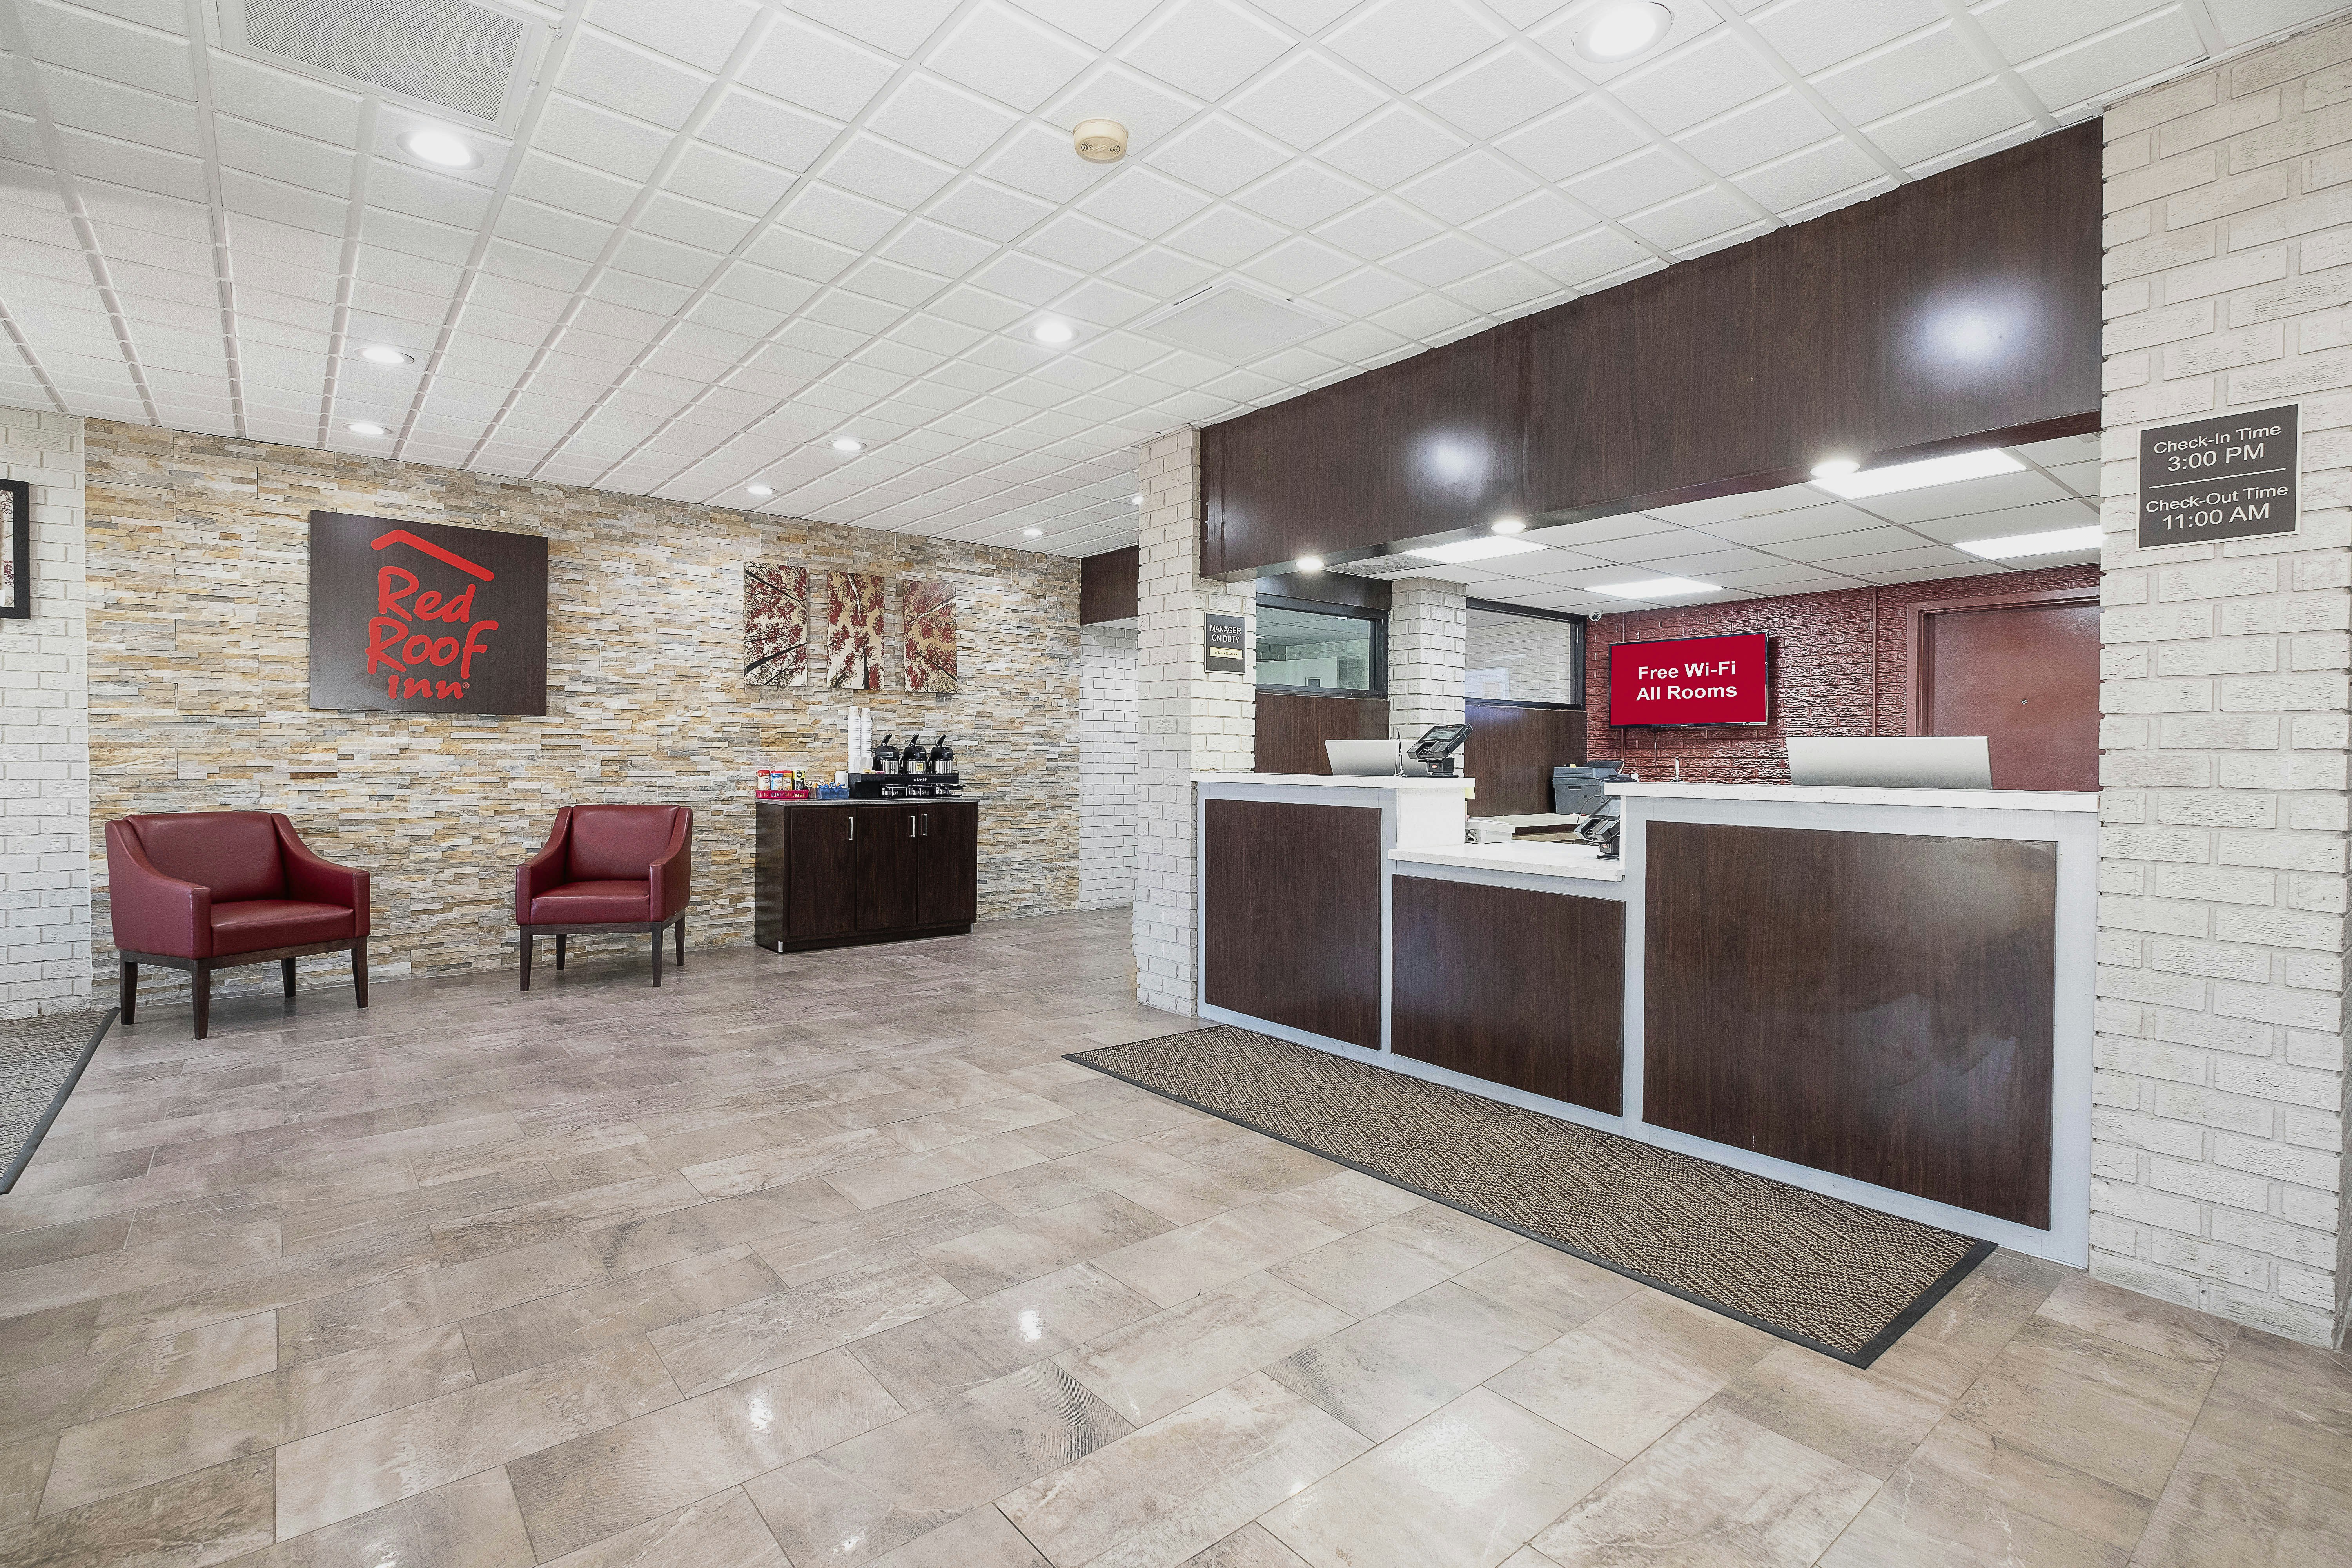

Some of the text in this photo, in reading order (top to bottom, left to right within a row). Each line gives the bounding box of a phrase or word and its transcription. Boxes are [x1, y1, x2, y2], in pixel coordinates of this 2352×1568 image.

[2154, 426, 2281, 454] Check-In Time
[2168, 443, 2265, 472] 3:00 PM
[2146, 486, 2288, 513] Check-Out Time
[2163, 503, 2270, 530] 11:00 AM
[378, 566, 476, 623] Red
[1210, 624, 1242, 635] MANAGER
[1212, 634, 1240, 643] ON DUTY
[365, 617, 499, 679] Roof
[1639, 661, 1735, 680] Free Wi-Fi
[1636, 686, 1737, 701] All Rooms
